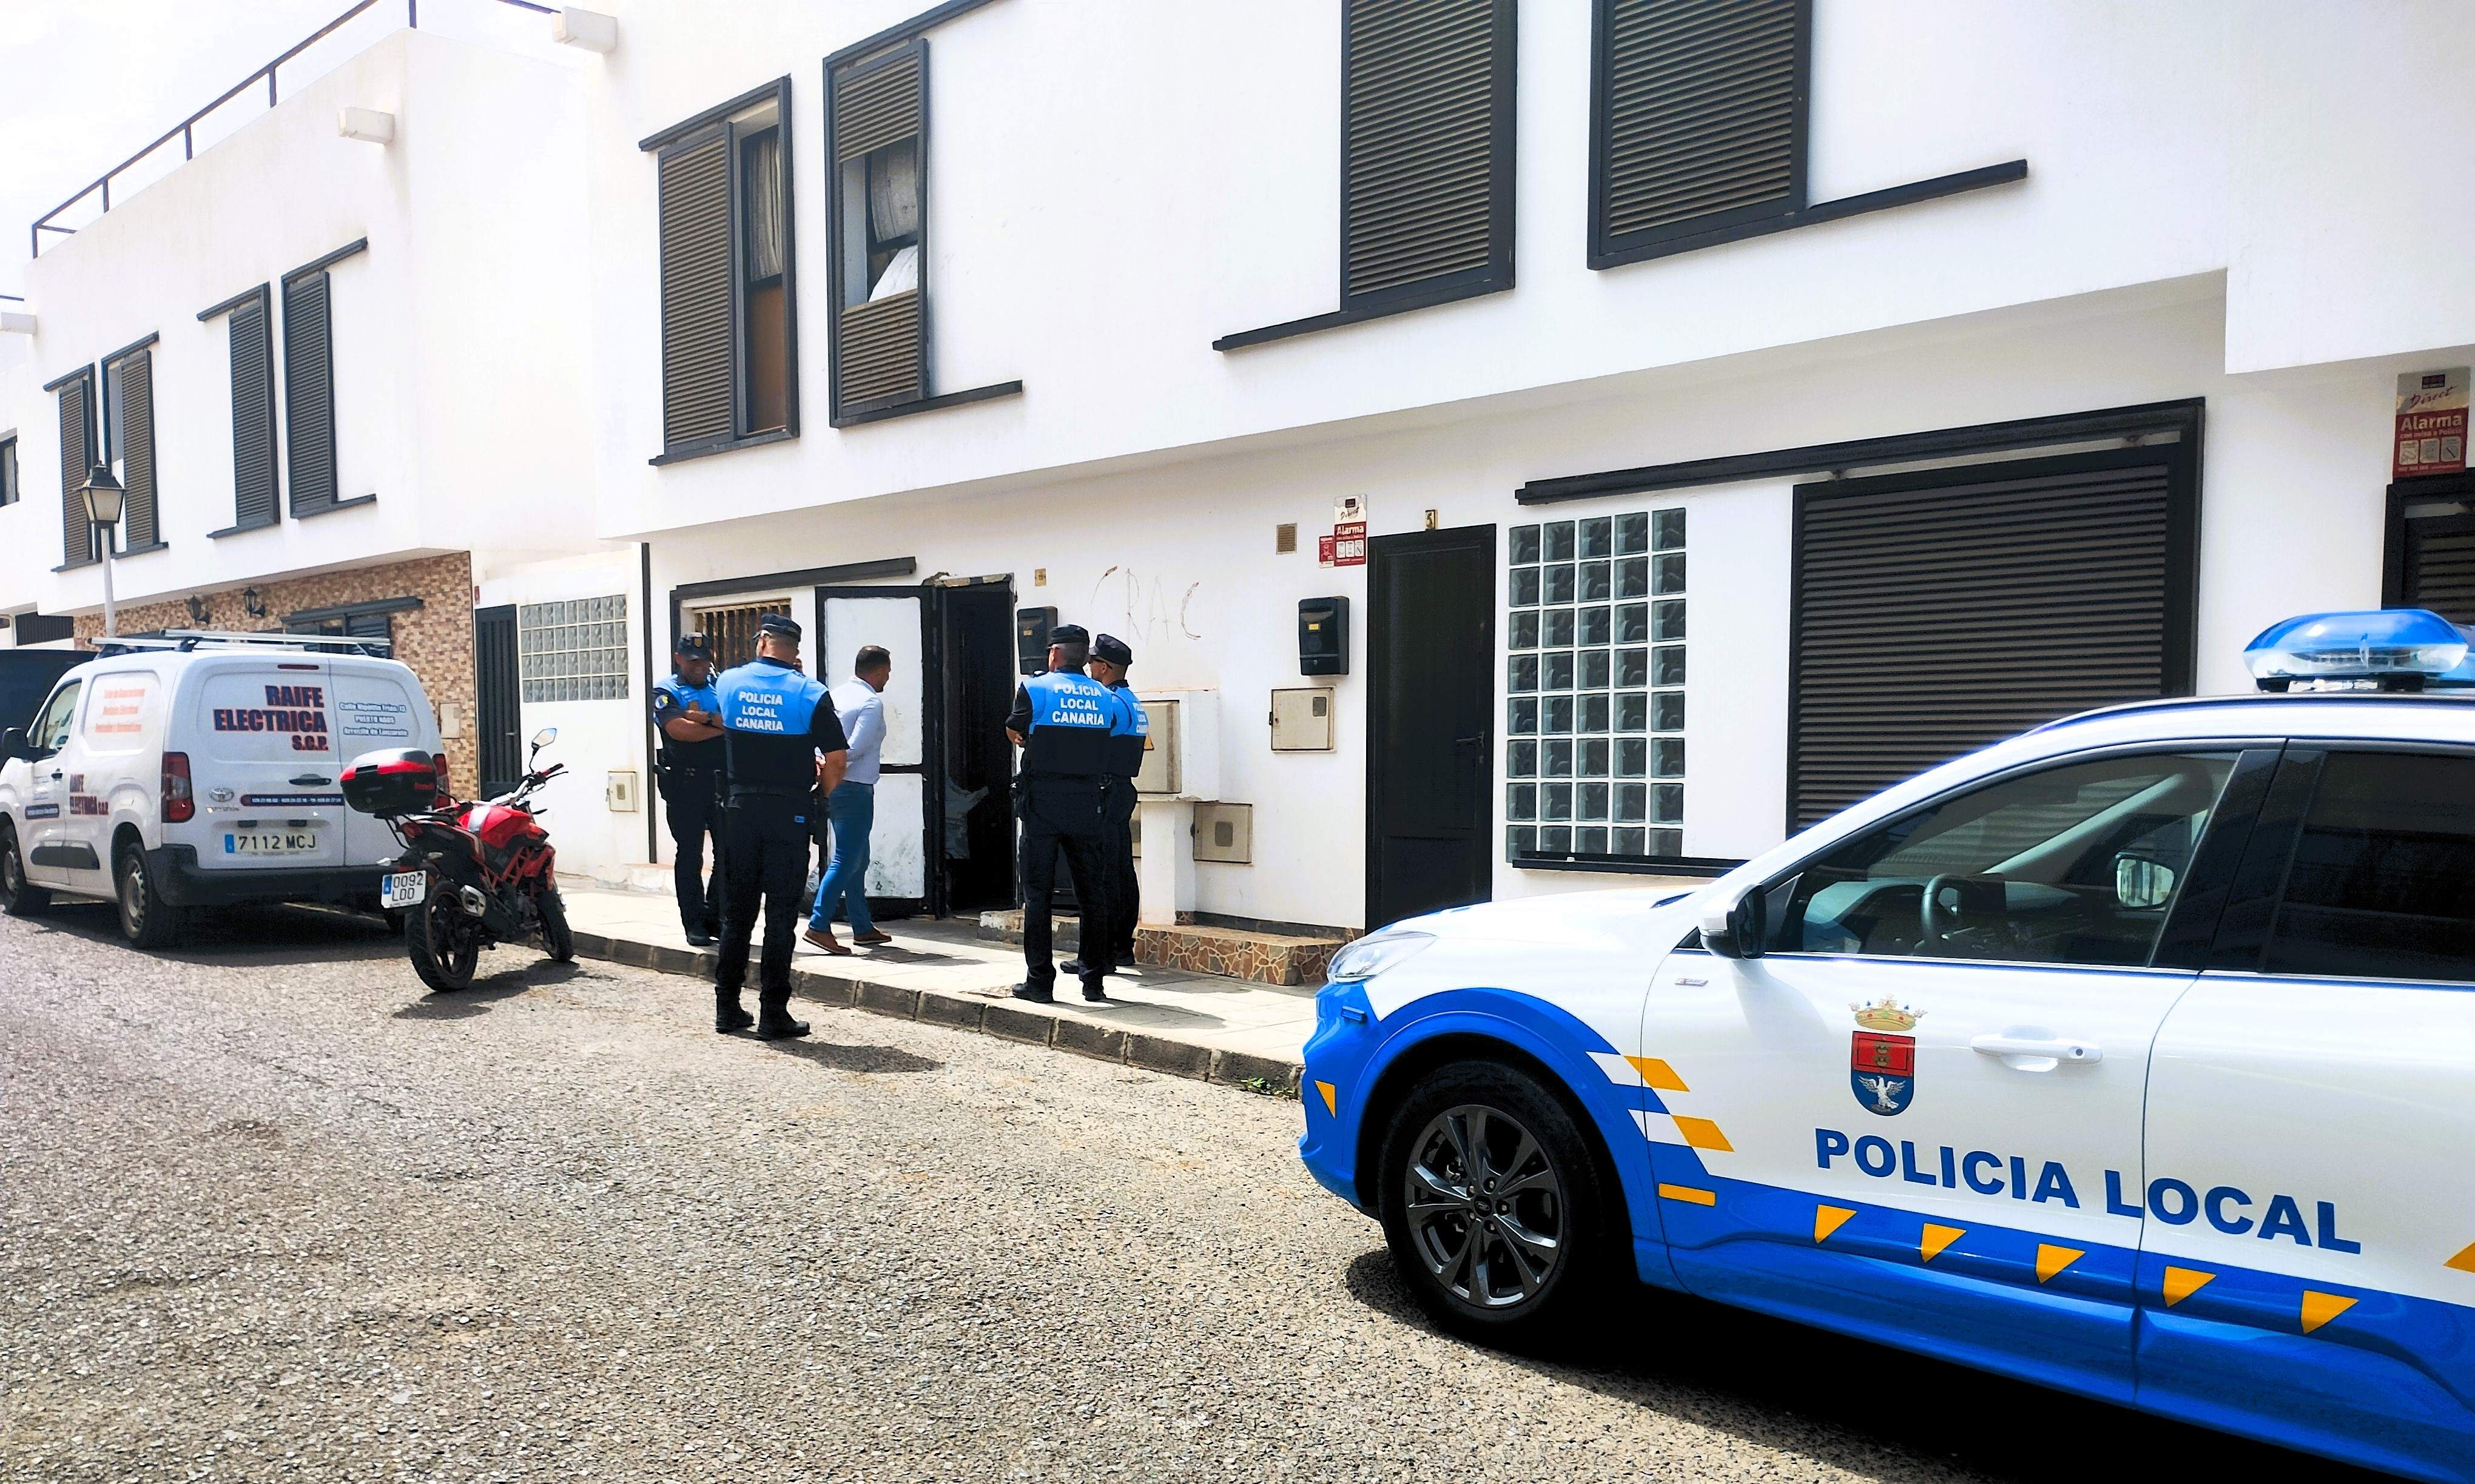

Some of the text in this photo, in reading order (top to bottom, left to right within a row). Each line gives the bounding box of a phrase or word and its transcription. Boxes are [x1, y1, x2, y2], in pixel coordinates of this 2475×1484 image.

[2400, 415, 2462, 431] Alarma
[1336, 525, 1365, 536] Alarma
[264, 685, 325, 708] RAIFE
[1053, 683, 1102, 697] POLICIA
[738, 691, 784, 706] POLICIA
[1060, 697, 1099, 711] LOCAL
[741, 705, 778, 718] LOCAL
[1051, 711, 1105, 726] CANARIA
[214, 708, 328, 733] ELECTRICA
[735, 717, 784, 731] CANARIA
[238, 834, 316, 850] 7112 MCJ
[393, 872, 423, 888] 0092
[1814, 1128, 2362, 1254] POLICIA LOCAL
